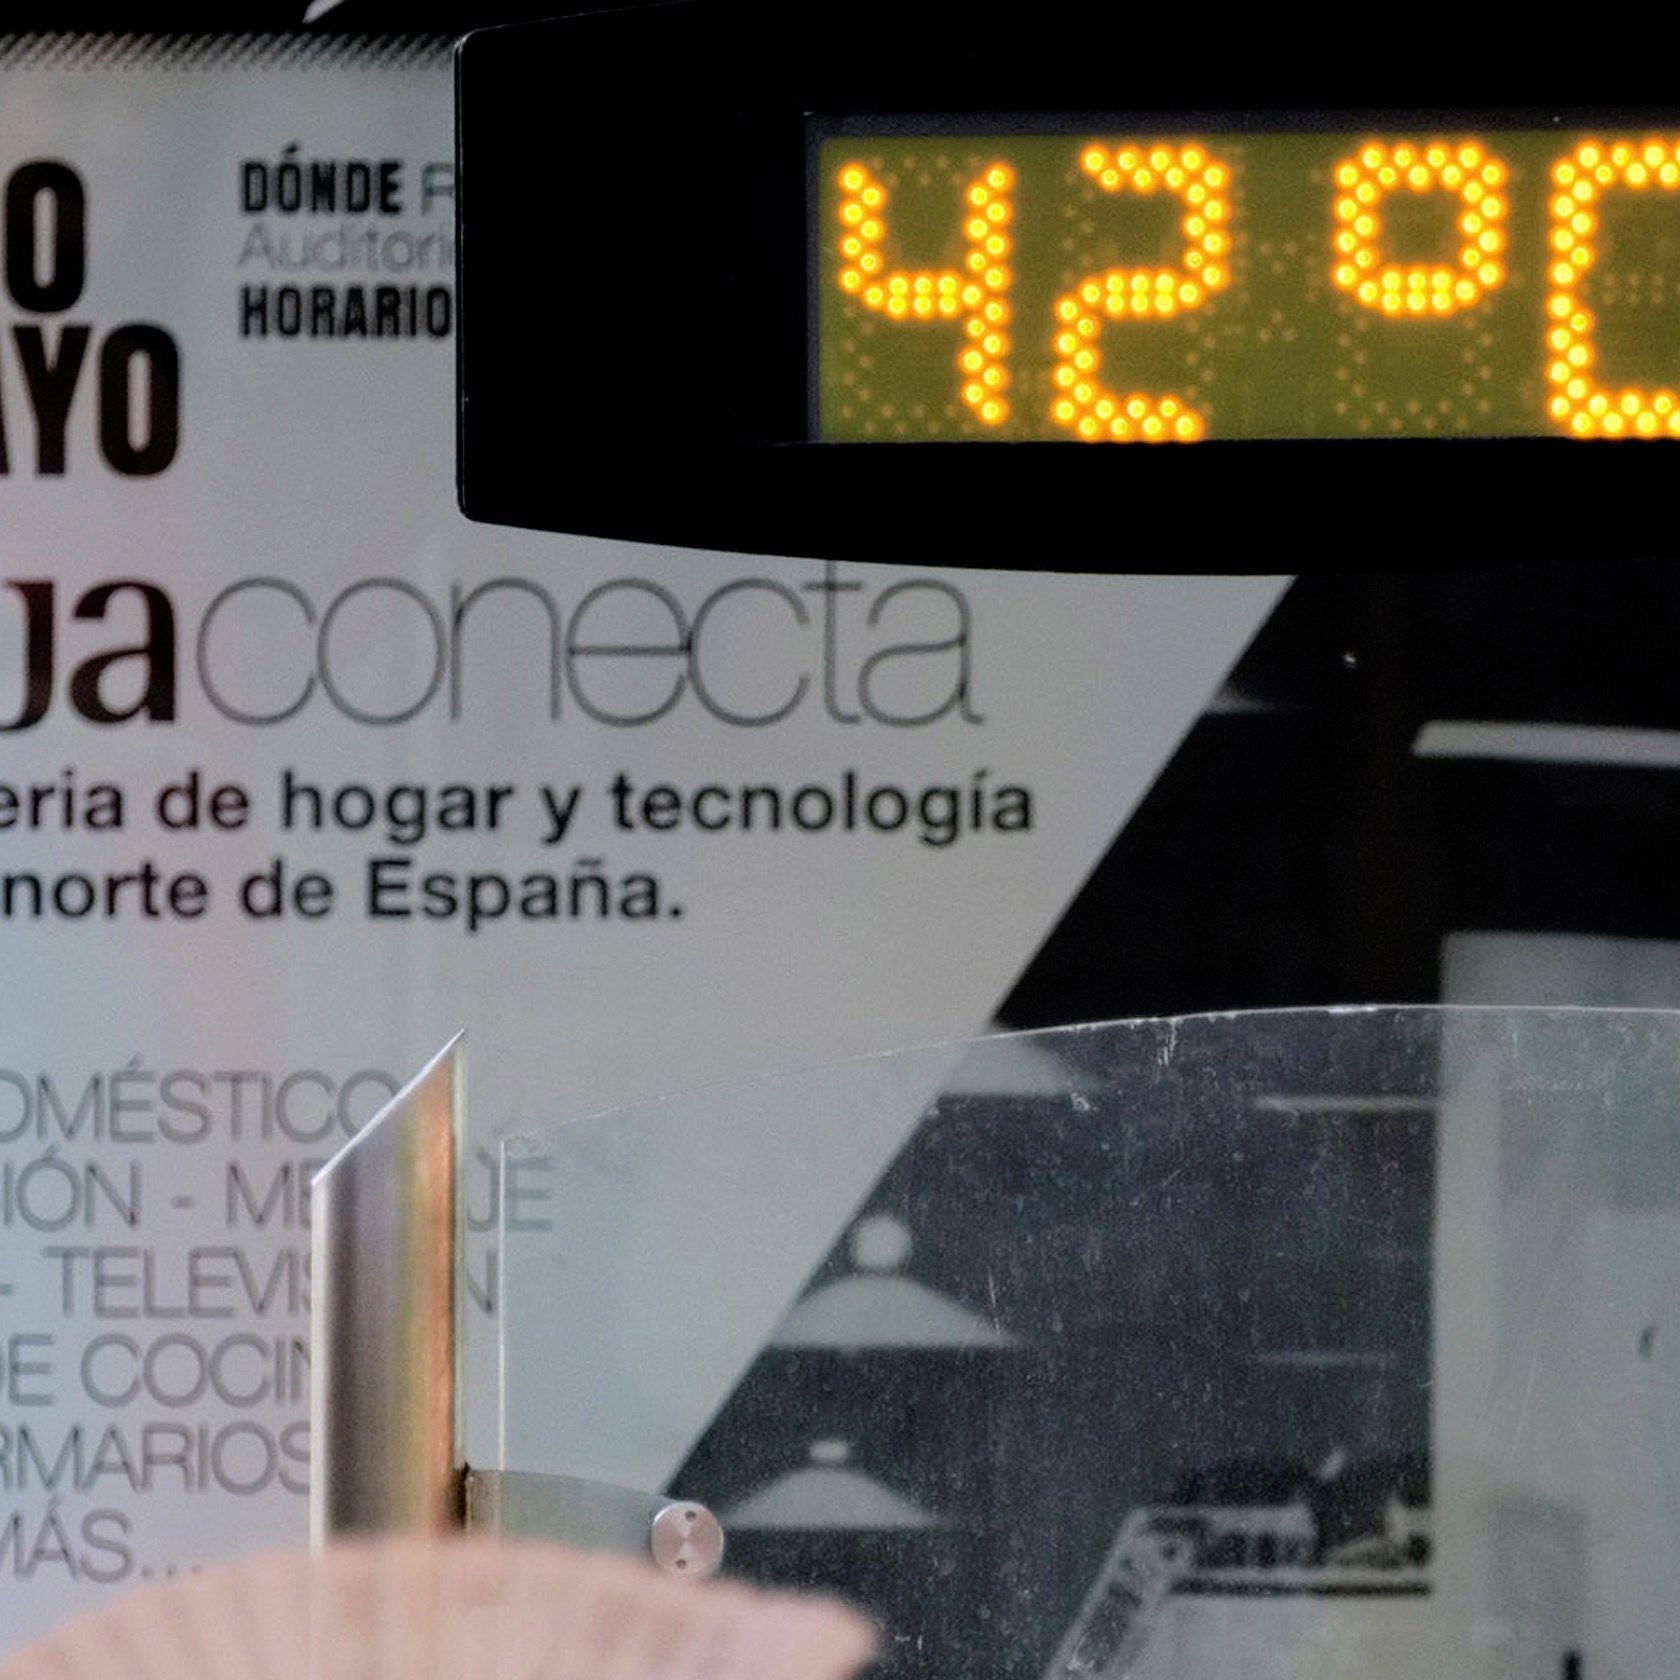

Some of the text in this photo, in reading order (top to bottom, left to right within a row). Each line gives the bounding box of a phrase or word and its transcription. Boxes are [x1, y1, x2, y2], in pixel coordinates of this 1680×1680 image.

[241, 143, 403, 216] DÓNDE
[238, 221, 454, 272] Auditori
[241, 284, 452, 340] HORARIO
[838, 142, 1232, 442] 42
[156, 770, 250, 831] de
[282, 770, 516, 847] hogar
[541, 786, 582, 848] y
[609, 769, 1033, 848] tecnología
[2, 862, 210, 919] norte
[239, 858, 335, 920] de
[367, 857, 683, 933] España.
